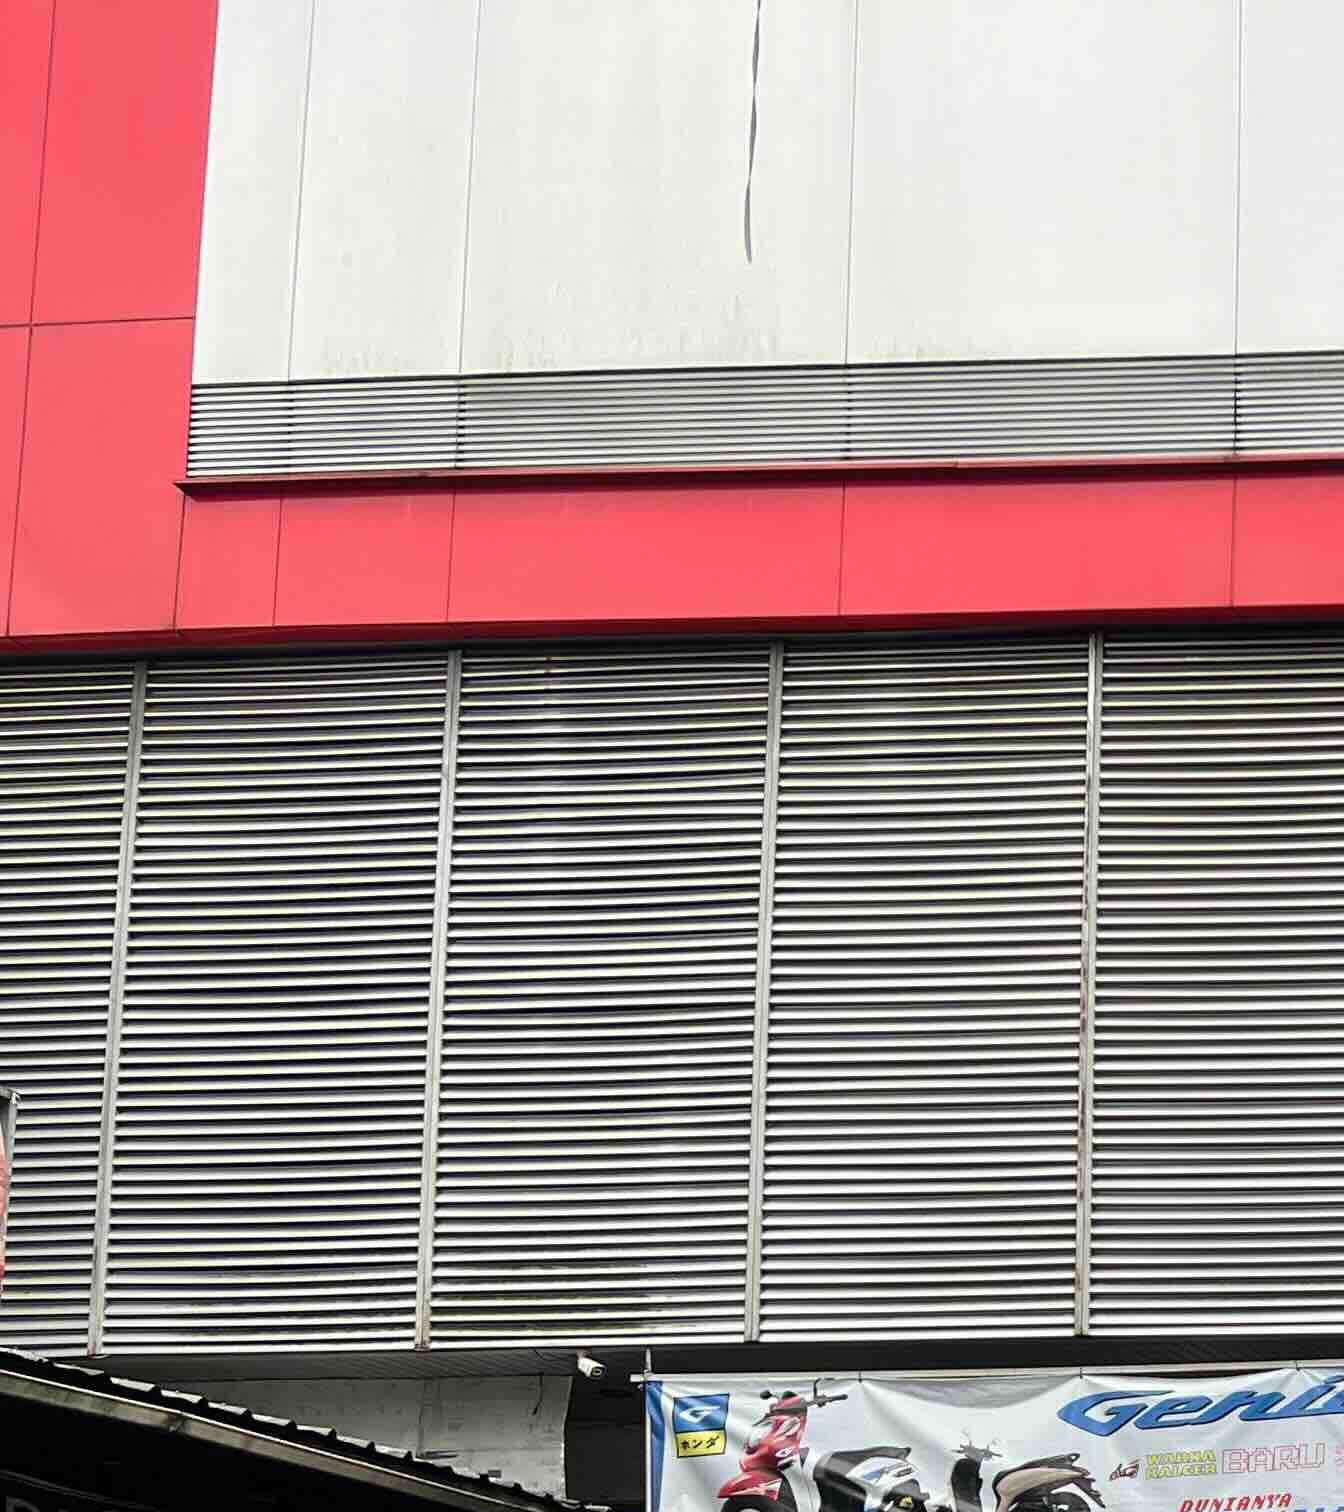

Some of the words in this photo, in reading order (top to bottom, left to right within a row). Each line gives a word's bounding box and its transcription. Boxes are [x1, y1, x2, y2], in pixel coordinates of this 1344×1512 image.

[681, 1435, 720, 1450] ホンダ
[1222, 1444, 1328, 1475] BARU
